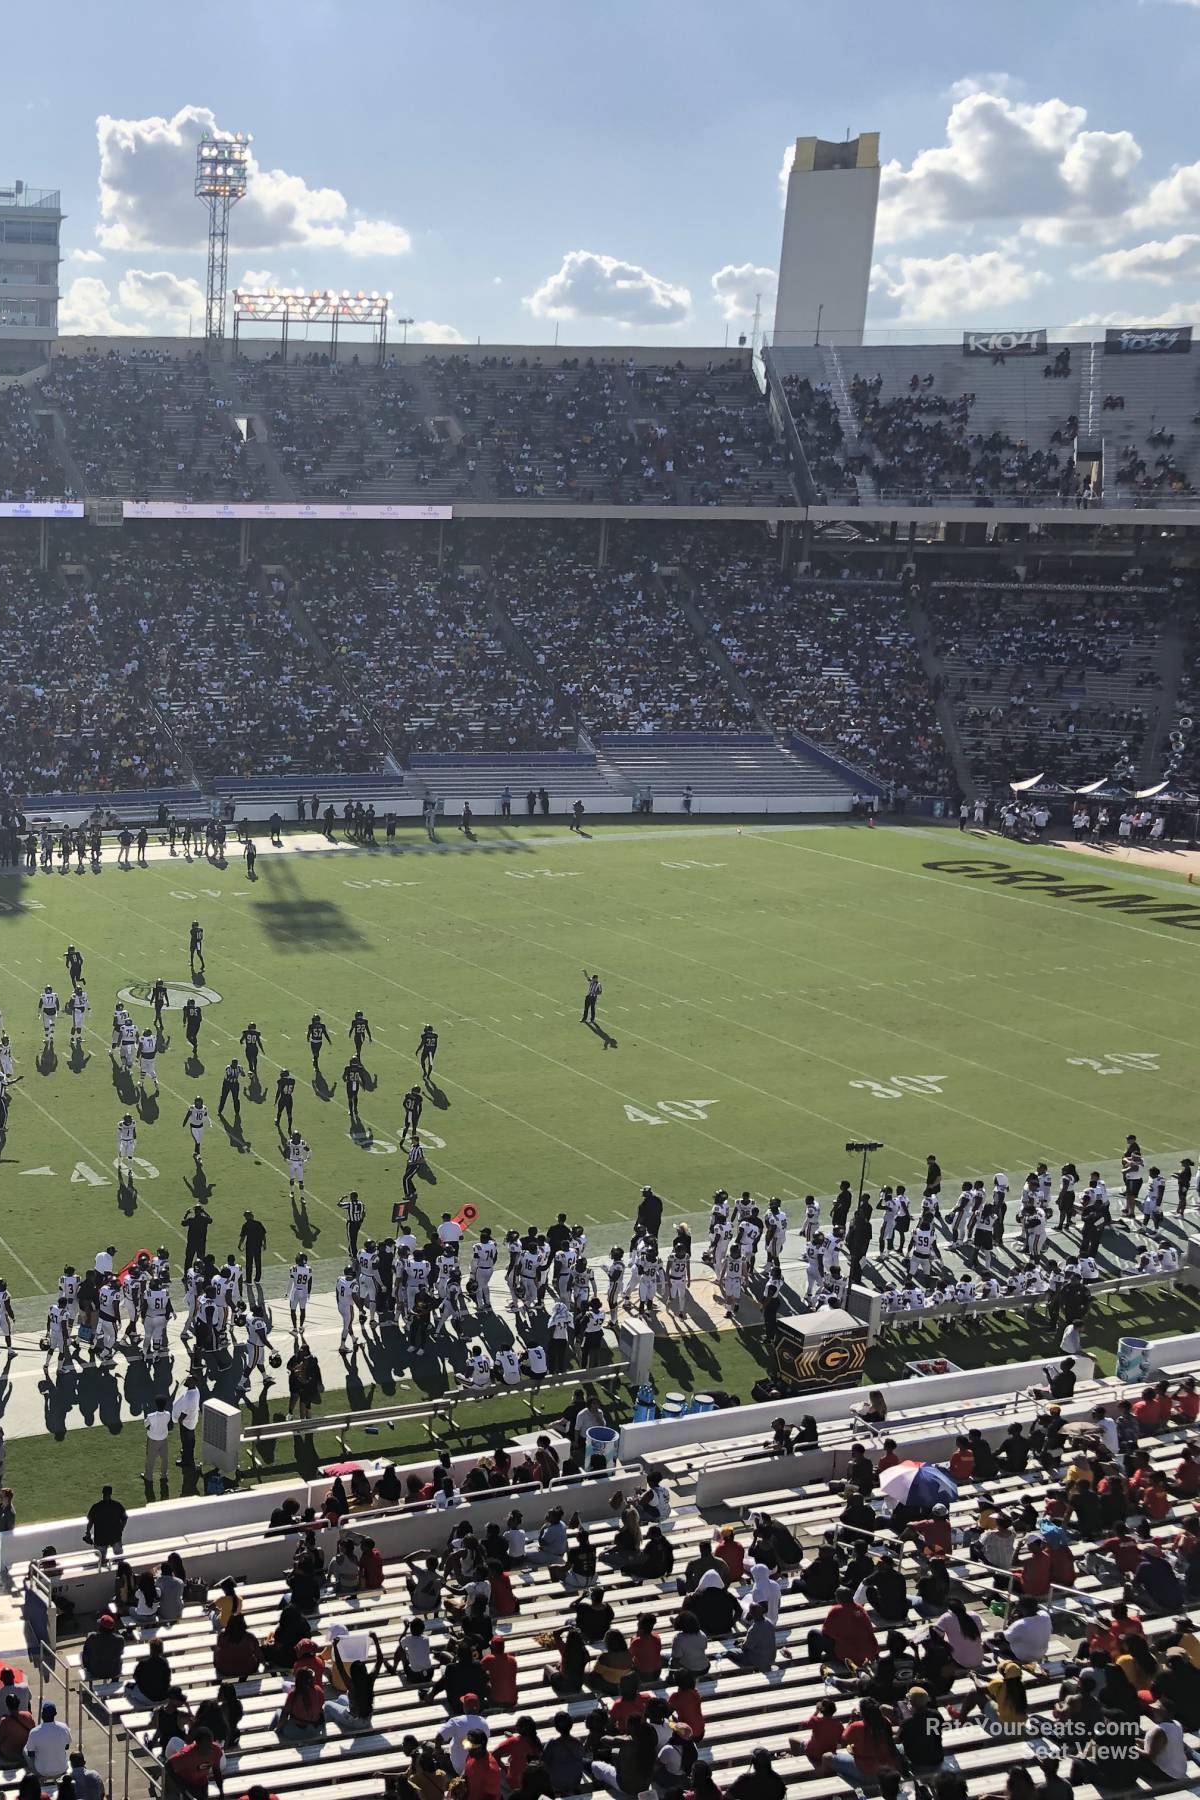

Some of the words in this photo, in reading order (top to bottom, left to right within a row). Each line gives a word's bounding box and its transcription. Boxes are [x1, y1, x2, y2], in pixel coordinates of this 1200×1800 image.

[125, 1029, 134, 1038] 75
[313, 1028, 322, 1037] 57
[356, 1024, 366, 1033] 22
[246, 1034, 257, 1044] 90
[848, 1075, 944, 1099] 30
[196, 1112, 203, 1120] 10
[623, 1099, 709, 1126] 40
[292, 1147, 300, 1156] 13
[70, 1156, 160, 1187] 40
[398, 1204, 405, 1217] 1
[918, 1235, 929, 1247] 59
[525, 1259, 533, 1270] 16
[728, 1263, 740, 1273] 30
[413, 1268, 424, 1279] 72
[297, 1274, 308, 1285] 89
[68, 1283, 74, 1295] 3
[340, 1286, 345, 1297] 8
[154, 1298, 164, 1310] 61
[916, 1294, 923, 1305] 5
[507, 1355, 514, 1366] 6
[478, 1362, 489, 1374] 50
